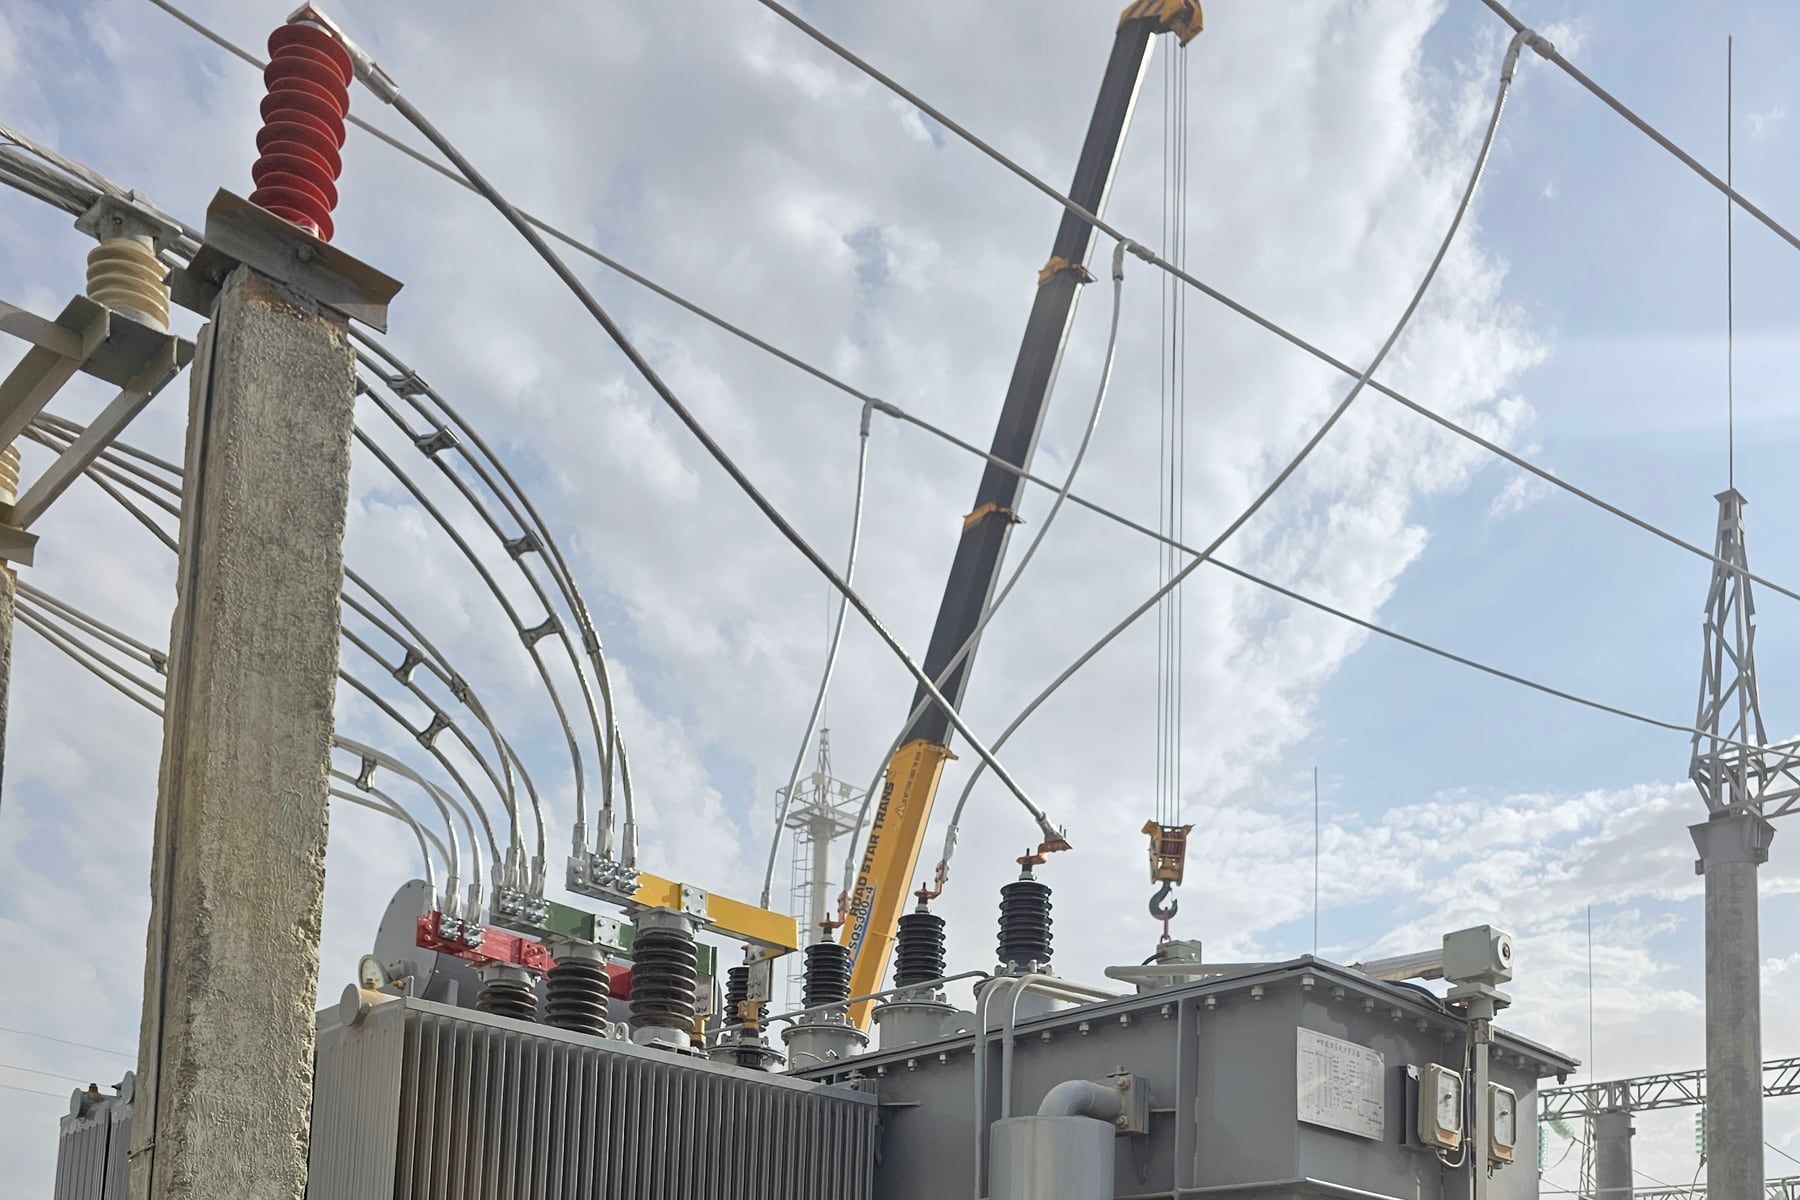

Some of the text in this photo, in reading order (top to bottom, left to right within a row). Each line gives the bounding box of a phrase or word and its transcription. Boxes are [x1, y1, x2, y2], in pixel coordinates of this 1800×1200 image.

[850, 782, 895, 917] ROAD STAR TRANS
[849, 886, 873, 950] SQS300-4
